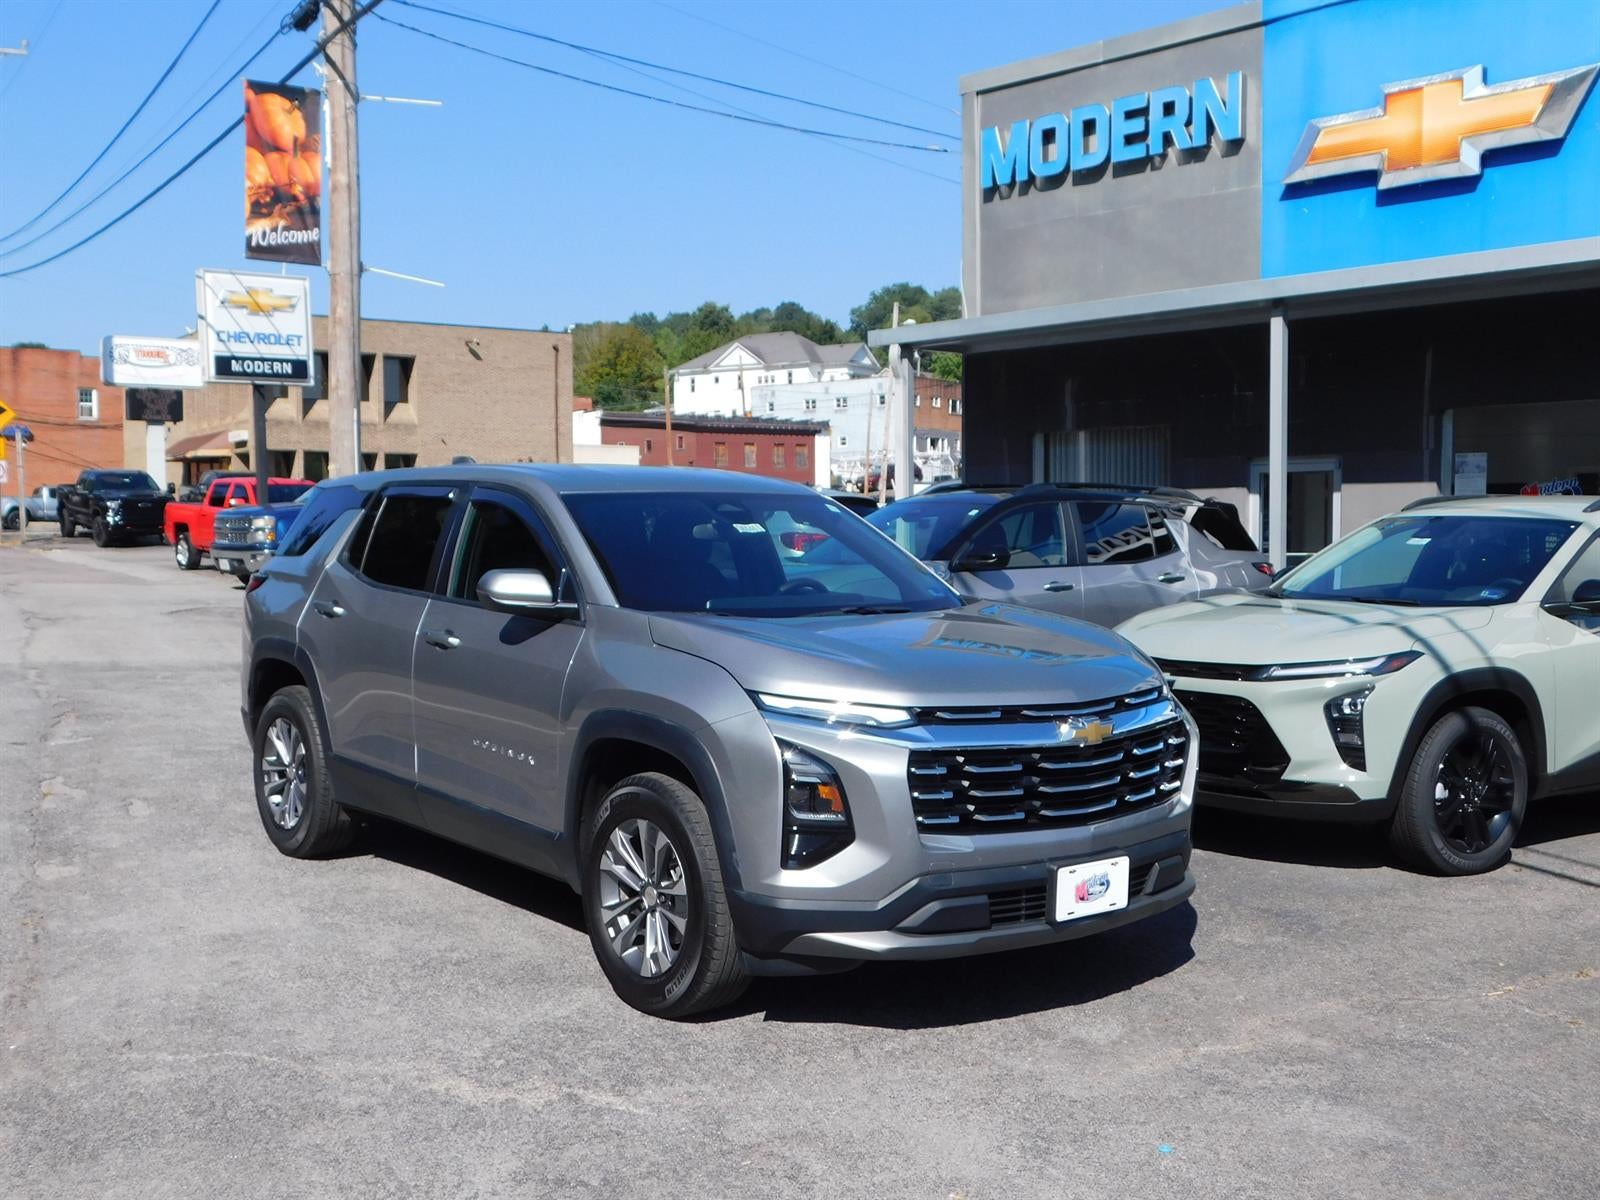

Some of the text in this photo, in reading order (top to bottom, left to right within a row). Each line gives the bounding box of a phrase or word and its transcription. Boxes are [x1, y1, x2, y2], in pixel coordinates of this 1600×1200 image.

[980, 70, 1244, 191] MODERN
[249, 222, 320, 247] Welcome
[216, 329, 304, 347] CHEVROLET
[230, 359, 293, 375] MODERN
